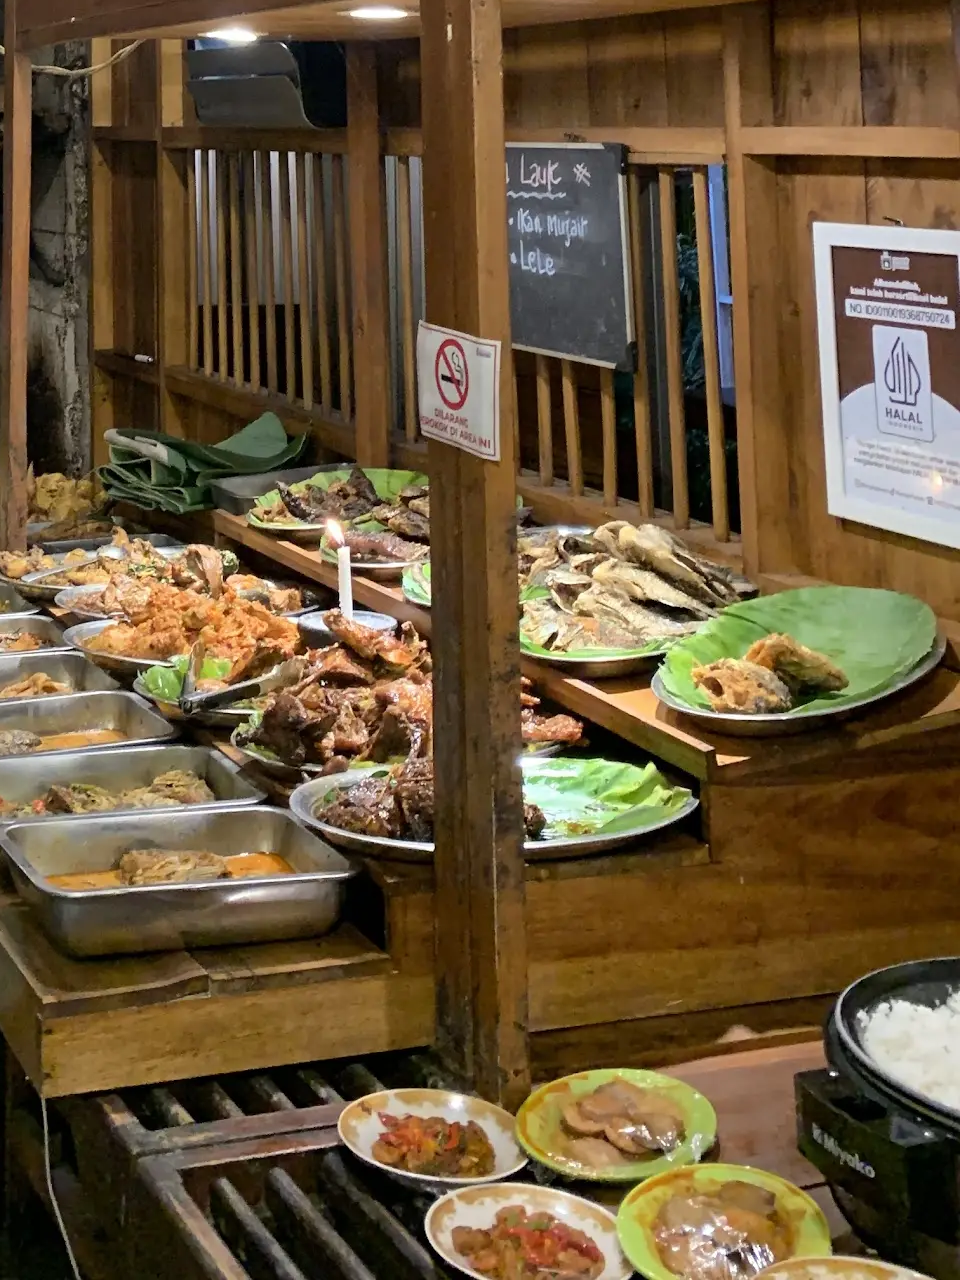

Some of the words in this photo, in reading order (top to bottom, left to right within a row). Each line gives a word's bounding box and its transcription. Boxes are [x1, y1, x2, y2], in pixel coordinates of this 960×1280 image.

[434, 407, 469, 428] DILARANG
[885, 407, 923, 424] HALAL
[460, 430, 477, 444] AREA
[478, 437, 491, 449] INI
